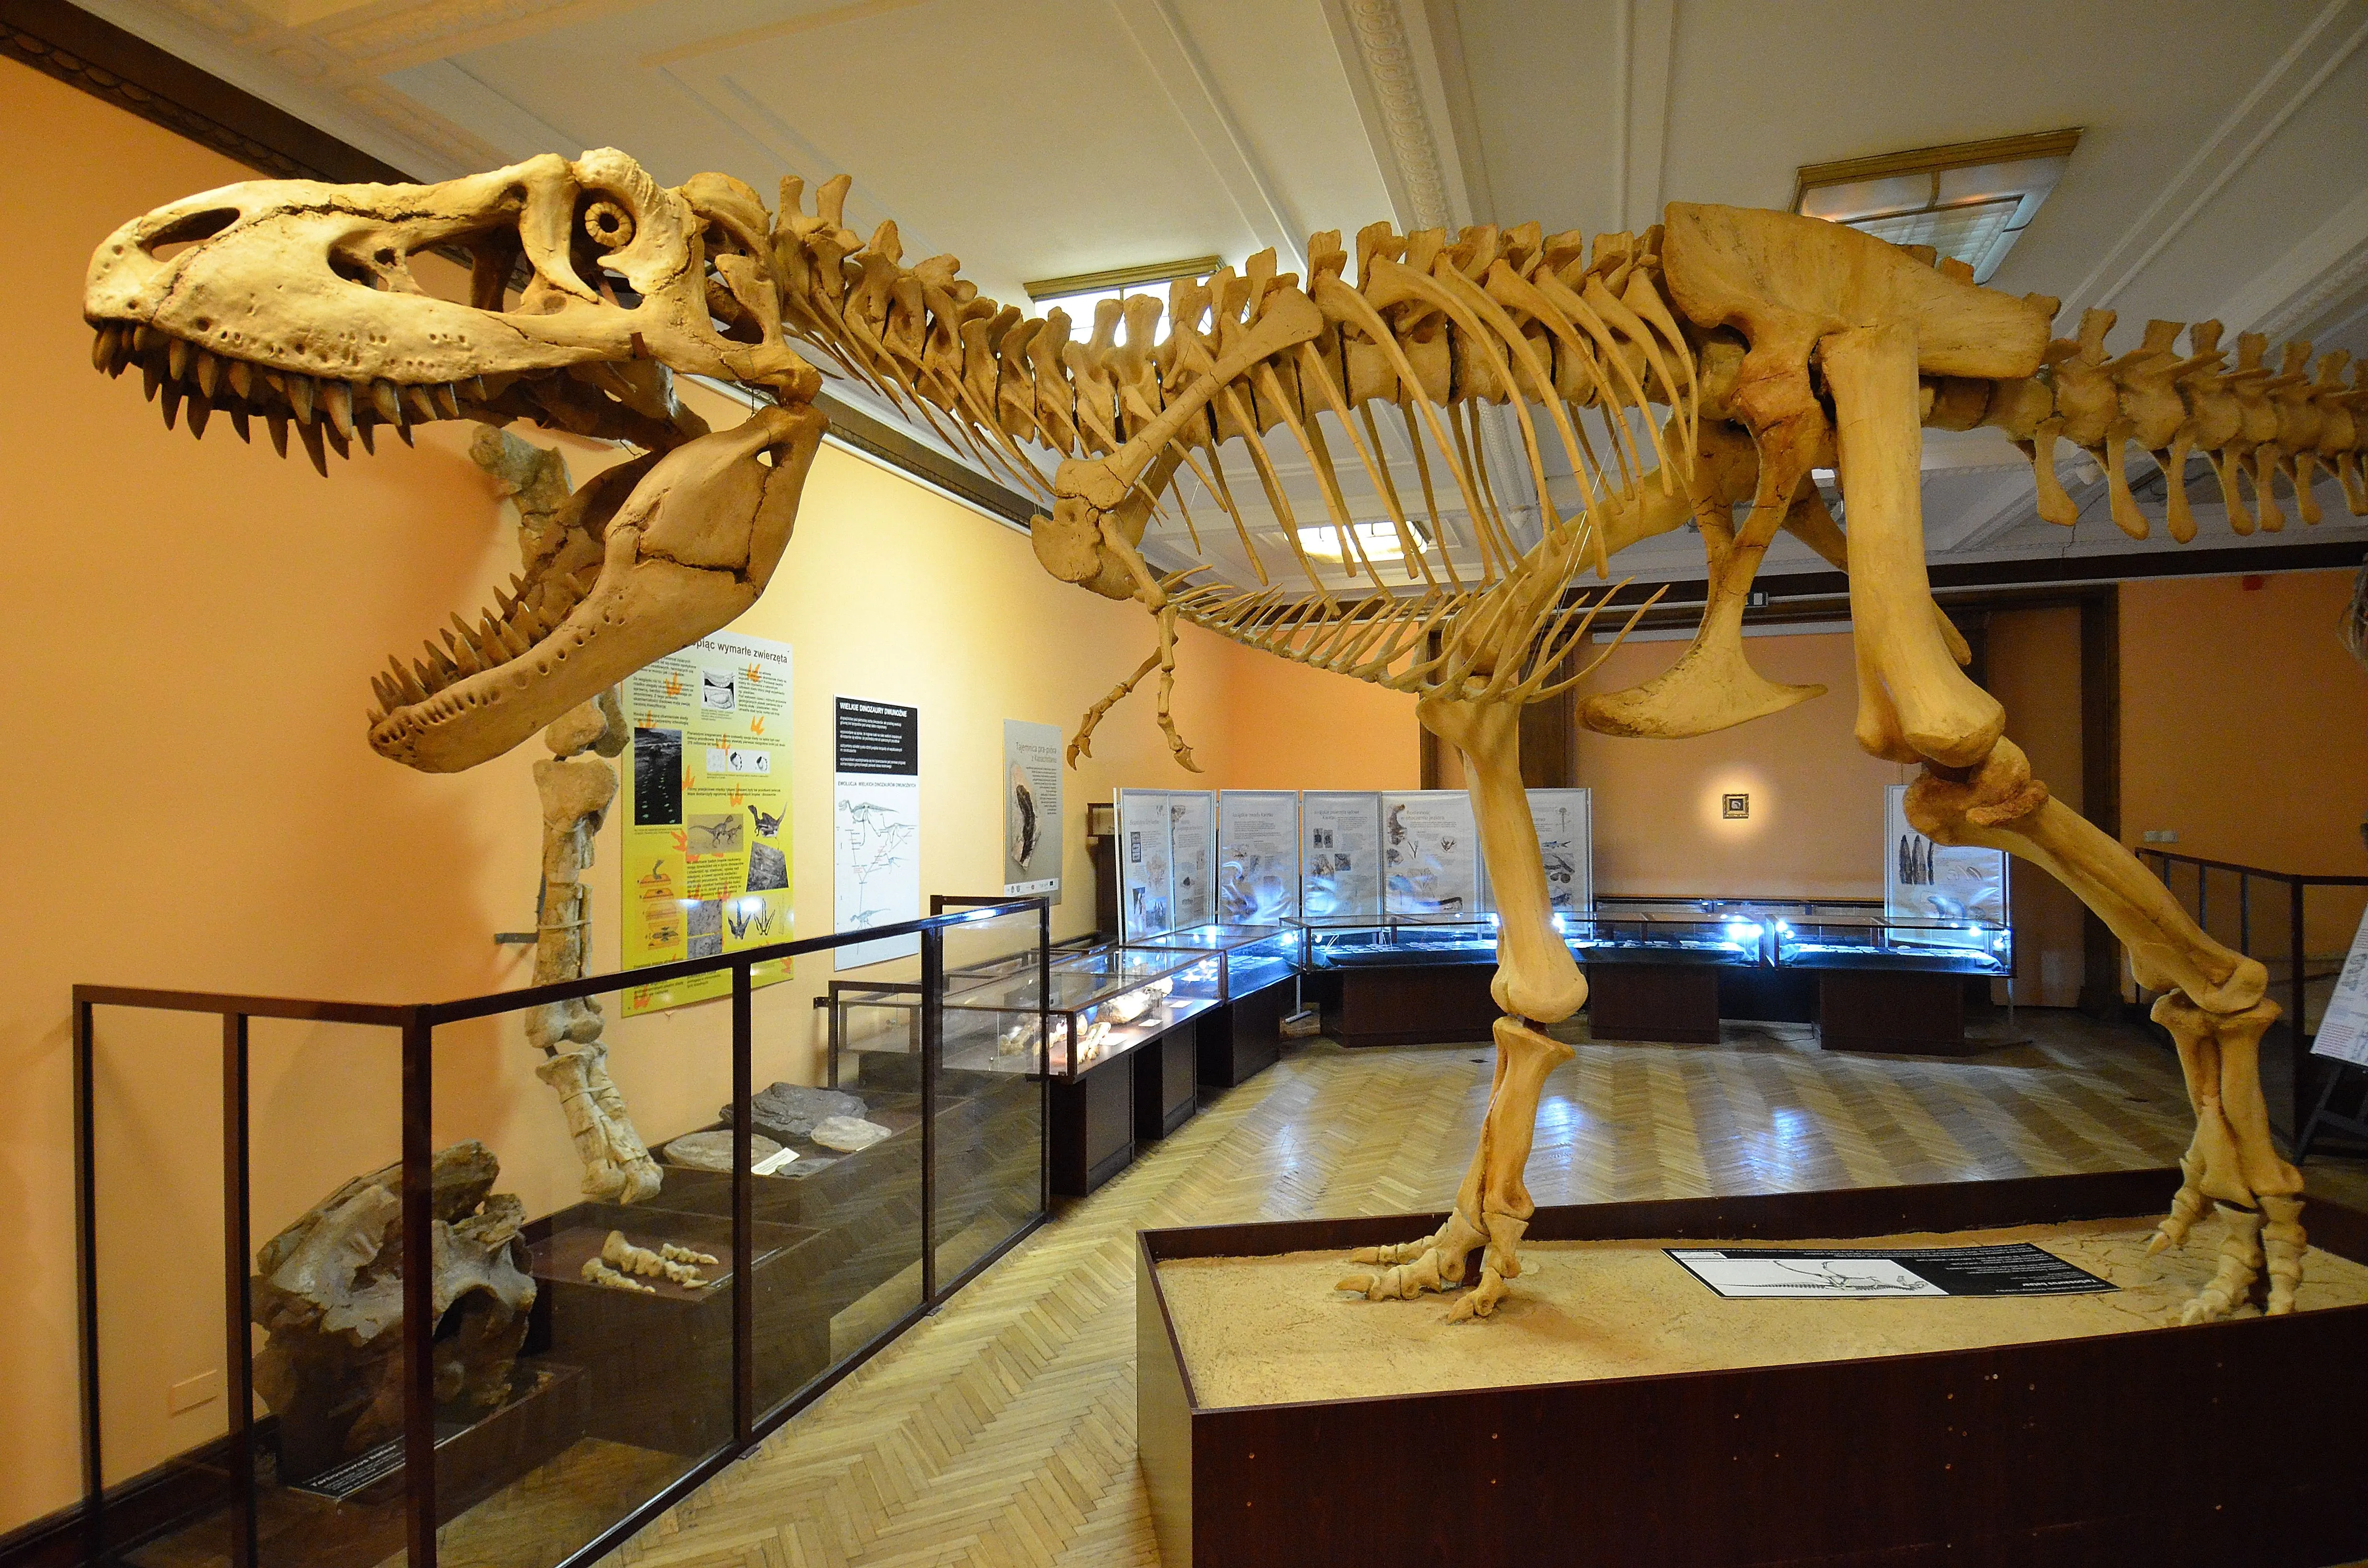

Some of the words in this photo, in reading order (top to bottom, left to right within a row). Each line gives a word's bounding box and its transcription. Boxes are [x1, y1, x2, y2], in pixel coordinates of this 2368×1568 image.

[717, 642, 751, 656] wymarłe
[753, 650, 787, 664] zwierzęta
[839, 702, 859, 711] WIELKIE
[860, 705, 884, 714] DINOZAURY
[884, 708, 907, 717] DWUNOŻNE
[1016, 742, 1037, 753] Tajemnica
